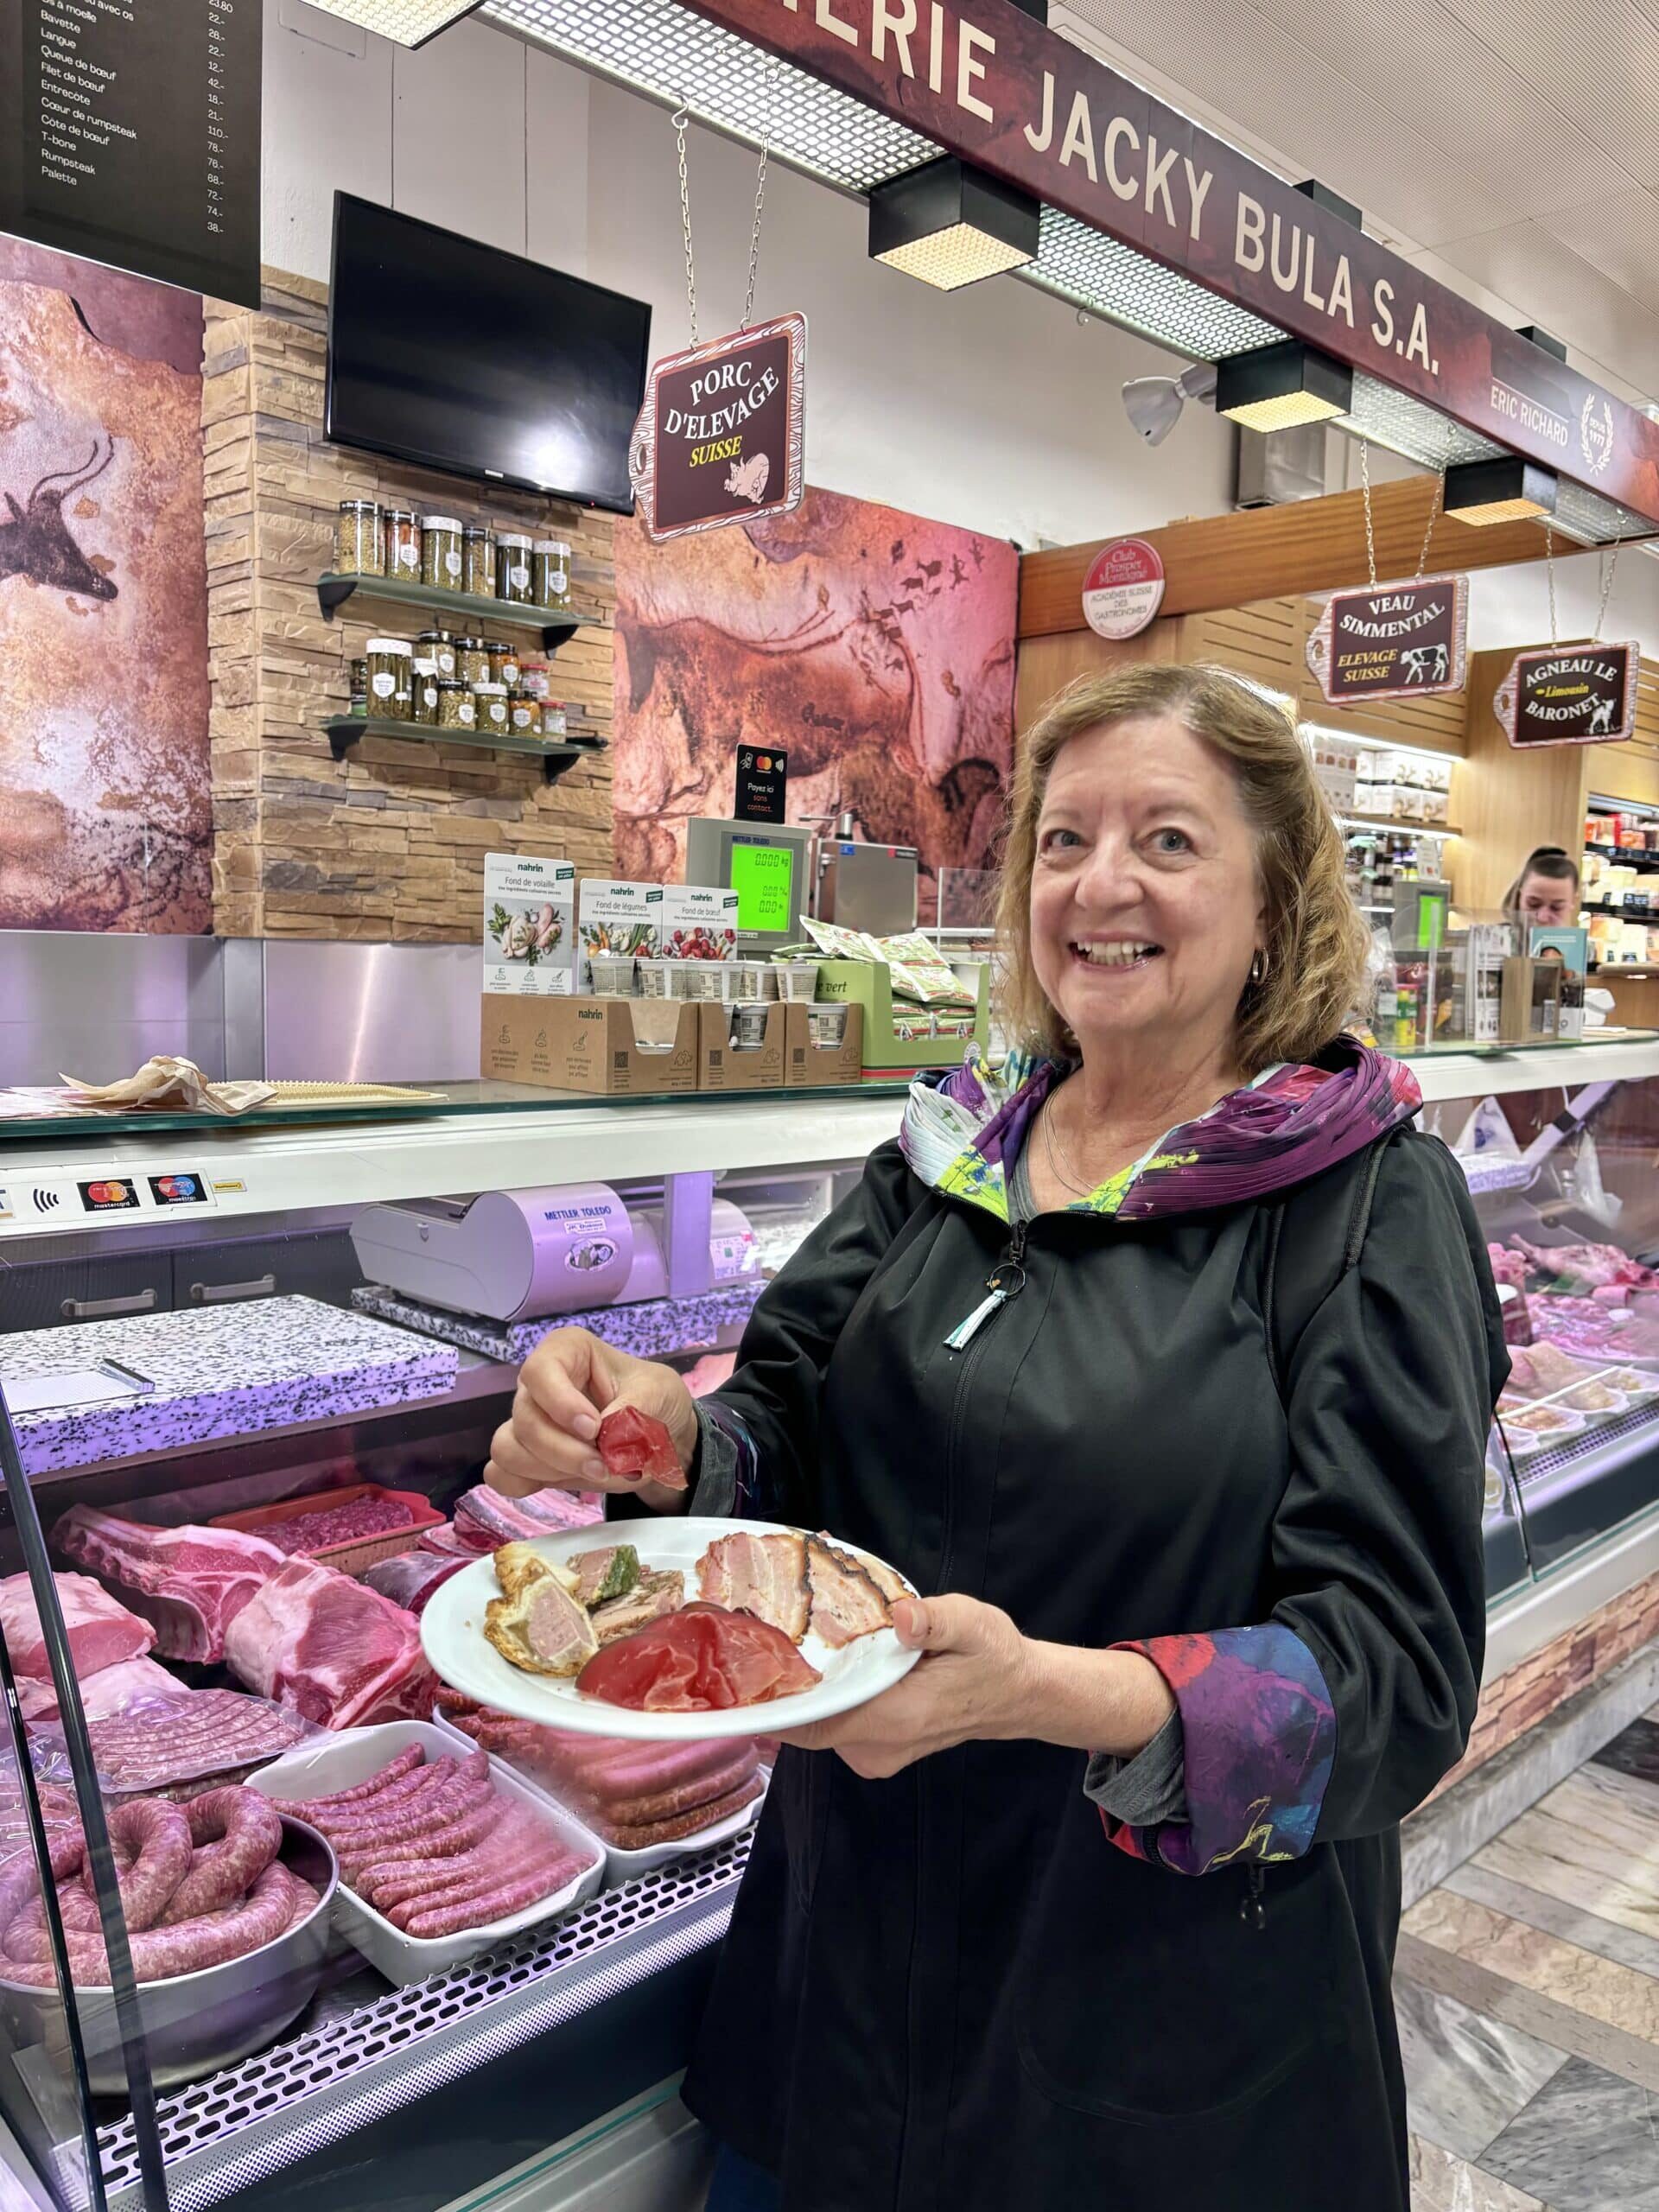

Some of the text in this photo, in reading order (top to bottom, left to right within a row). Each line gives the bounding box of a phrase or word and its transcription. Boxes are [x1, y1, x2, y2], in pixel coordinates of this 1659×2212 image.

[66, 4, 97, 22] moelle
[98, 0, 121, 16] avec
[41, 9, 81, 33] Bavette
[41, 27, 76, 48] Langue
[41, 45, 73, 64] Queue
[74, 59, 88, 71] de
[90, 62, 116, 81] bœuf
[41, 61, 62, 78] Filet
[63, 72, 76, 83] de
[78, 76, 105, 93] bœuf
[41, 97, 71, 114] Cœur
[73, 109, 85, 121] de
[86, 116, 137, 139] rumpsteak
[41, 131, 76, 150] T-bone
[68, 124, 81, 136] de
[83, 129, 110, 145] bœuf
[41, 149, 95, 175] Rumpsteak
[41, 166, 76, 185] Palette
[783, 0, 1439, 376] RIE JACKY BULA S.A.
[690, 362, 752, 406] PORC
[664, 367, 779, 440] D'ELEVAGE
[1491, 385, 1569, 447] ERIC RICHARD
[689, 435, 743, 467] SUISSE
[1112, 548, 1136, 563] Club
[1369, 595, 1415, 615] VEAU
[1339, 601, 1445, 638] SIMMENTAL
[1338, 648, 1398, 667] ELEVAGE
[1344, 666, 1389, 683] SUISSE
[1526, 658, 1618, 688] AGNEAU LE
[1545, 682, 1589, 698] Limousin
[1525, 693, 1600, 721] BARONET
[747, 783, 766, 793] Payez
[518, 863, 543, 873] nahrin
[505, 876, 556, 888] Fond de volaille
[610, 887, 634, 896] nahrin
[596, 900, 648, 912] Fond de légumes
[691, 893, 713, 902] nahrin
[682, 906, 697, 915] Fond
[826, 980, 848, 993] vert
[579, 1009, 603, 1020] nahrin
[94, 1201, 130, 1210] mastercard
[544, 1206, 612, 1220] METTLER TOLEDO
